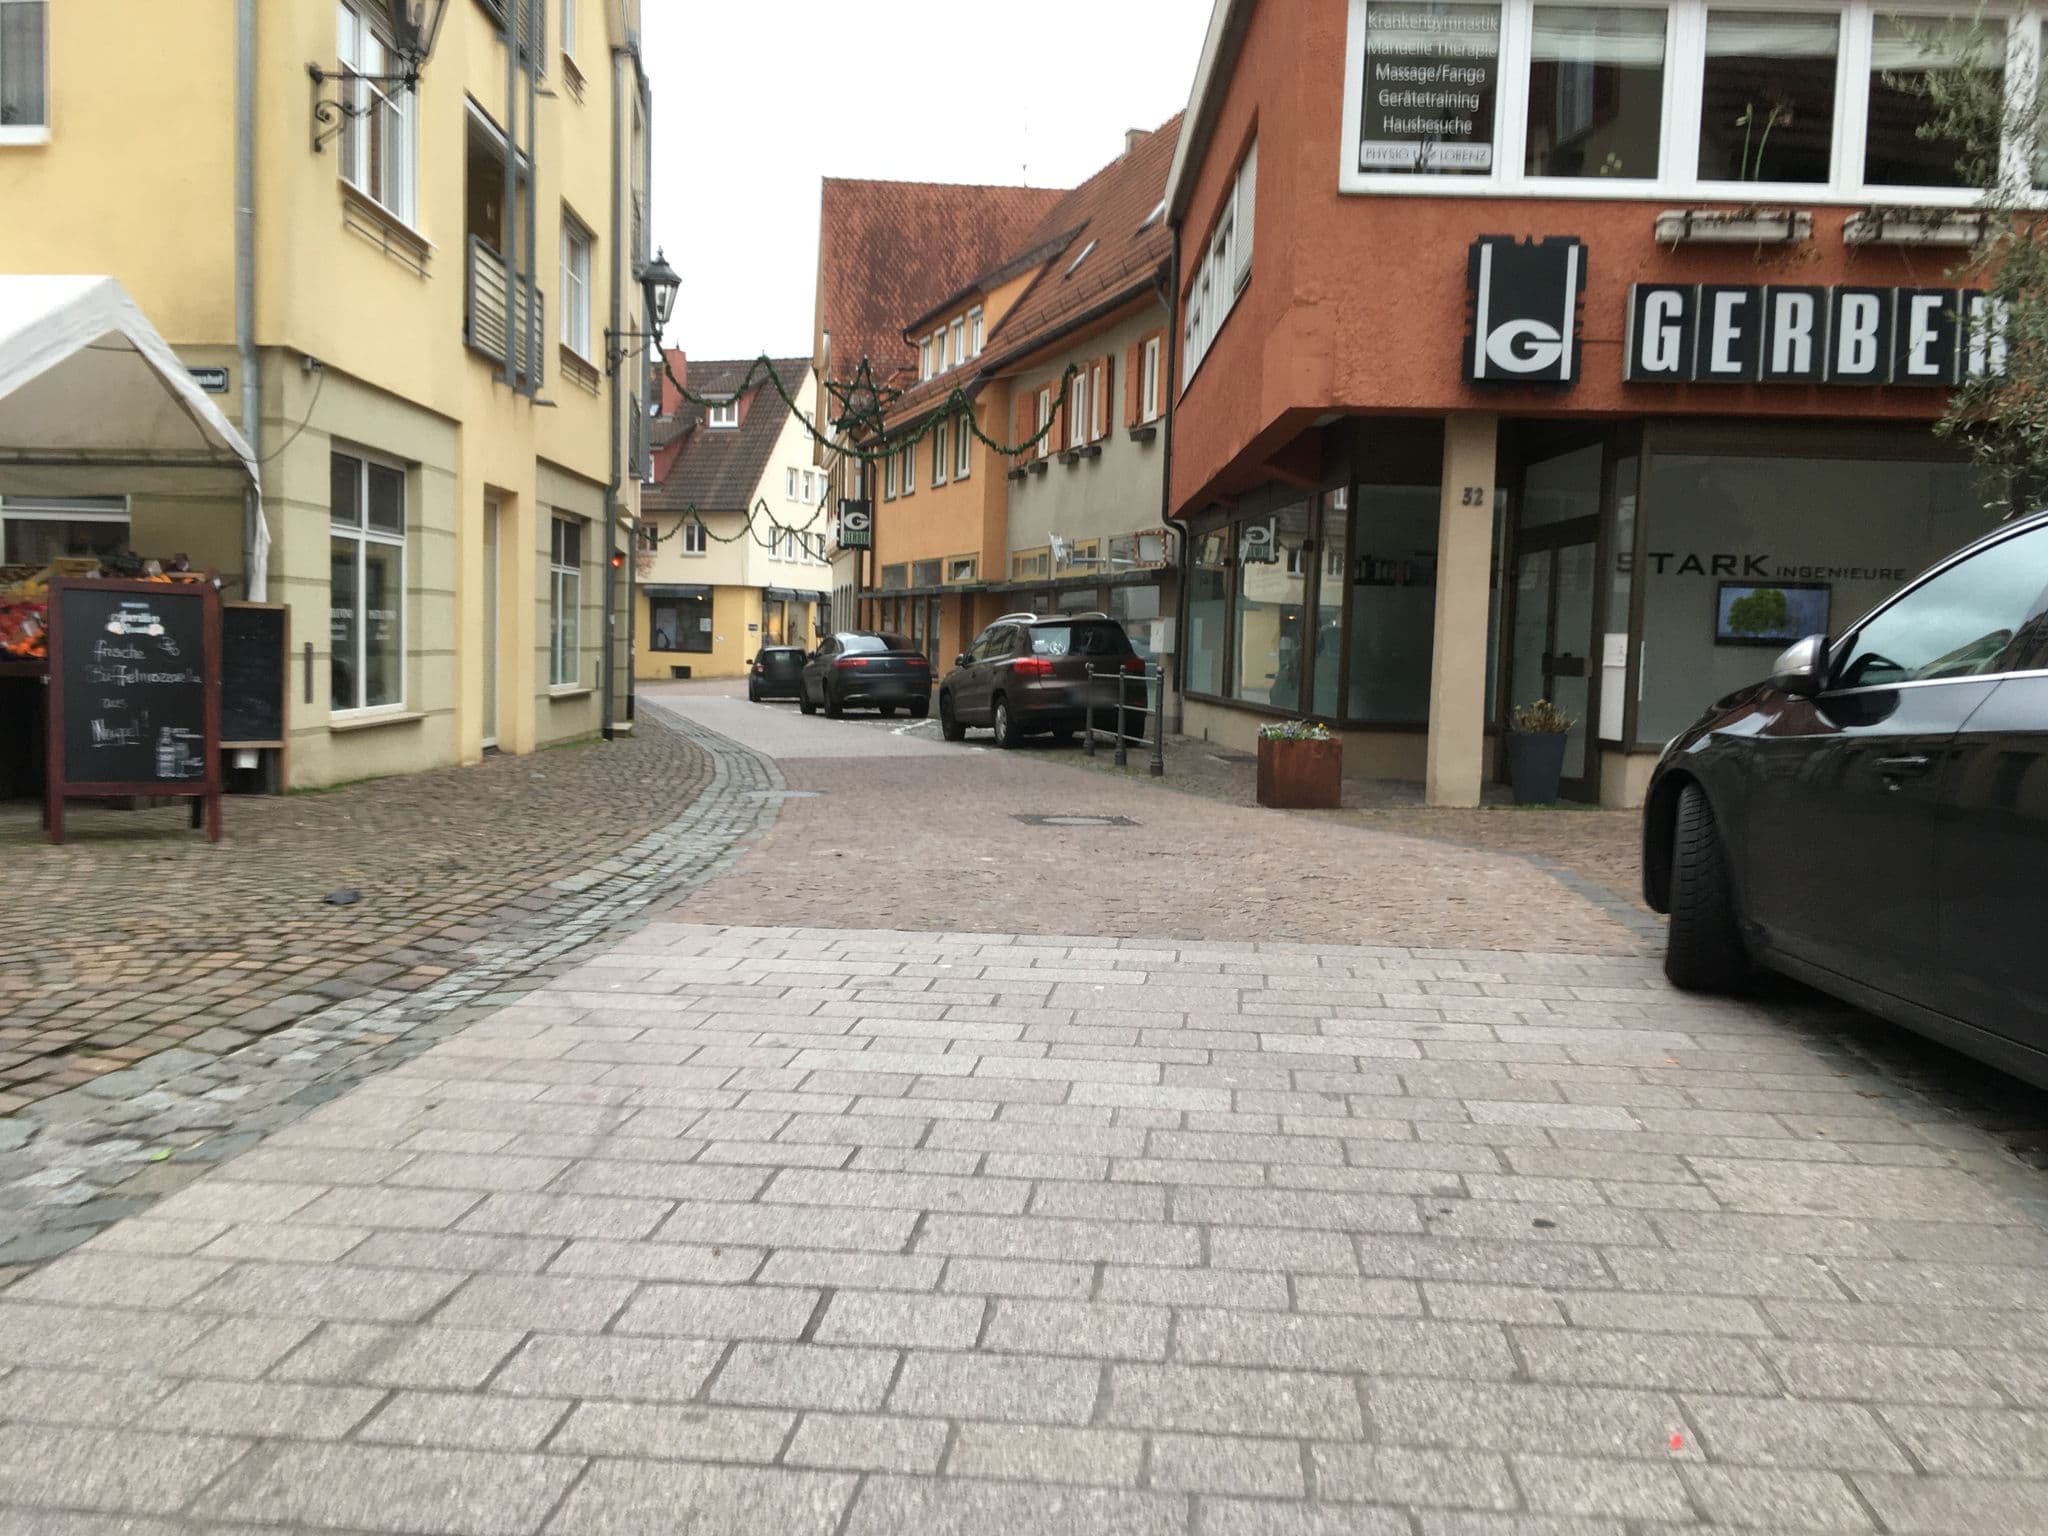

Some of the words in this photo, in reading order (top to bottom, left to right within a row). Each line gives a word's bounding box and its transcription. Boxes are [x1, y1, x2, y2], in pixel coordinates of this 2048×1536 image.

[1368, 10, 1499, 32] Krankengymnastik
[1367, 39, 1432, 56] Manuelle
[1438, 40, 1497, 59] Therapie
[1375, 63, 1486, 85] Massage/Fango
[1378, 89, 1480, 112] Gerätetraining
[1383, 115, 1473, 135] Hausbesuche
[1641, 290, 2010, 377] GERBER
[1462, 486, 1484, 507] 32
[1776, 565, 1906, 581] INGENIEURE
